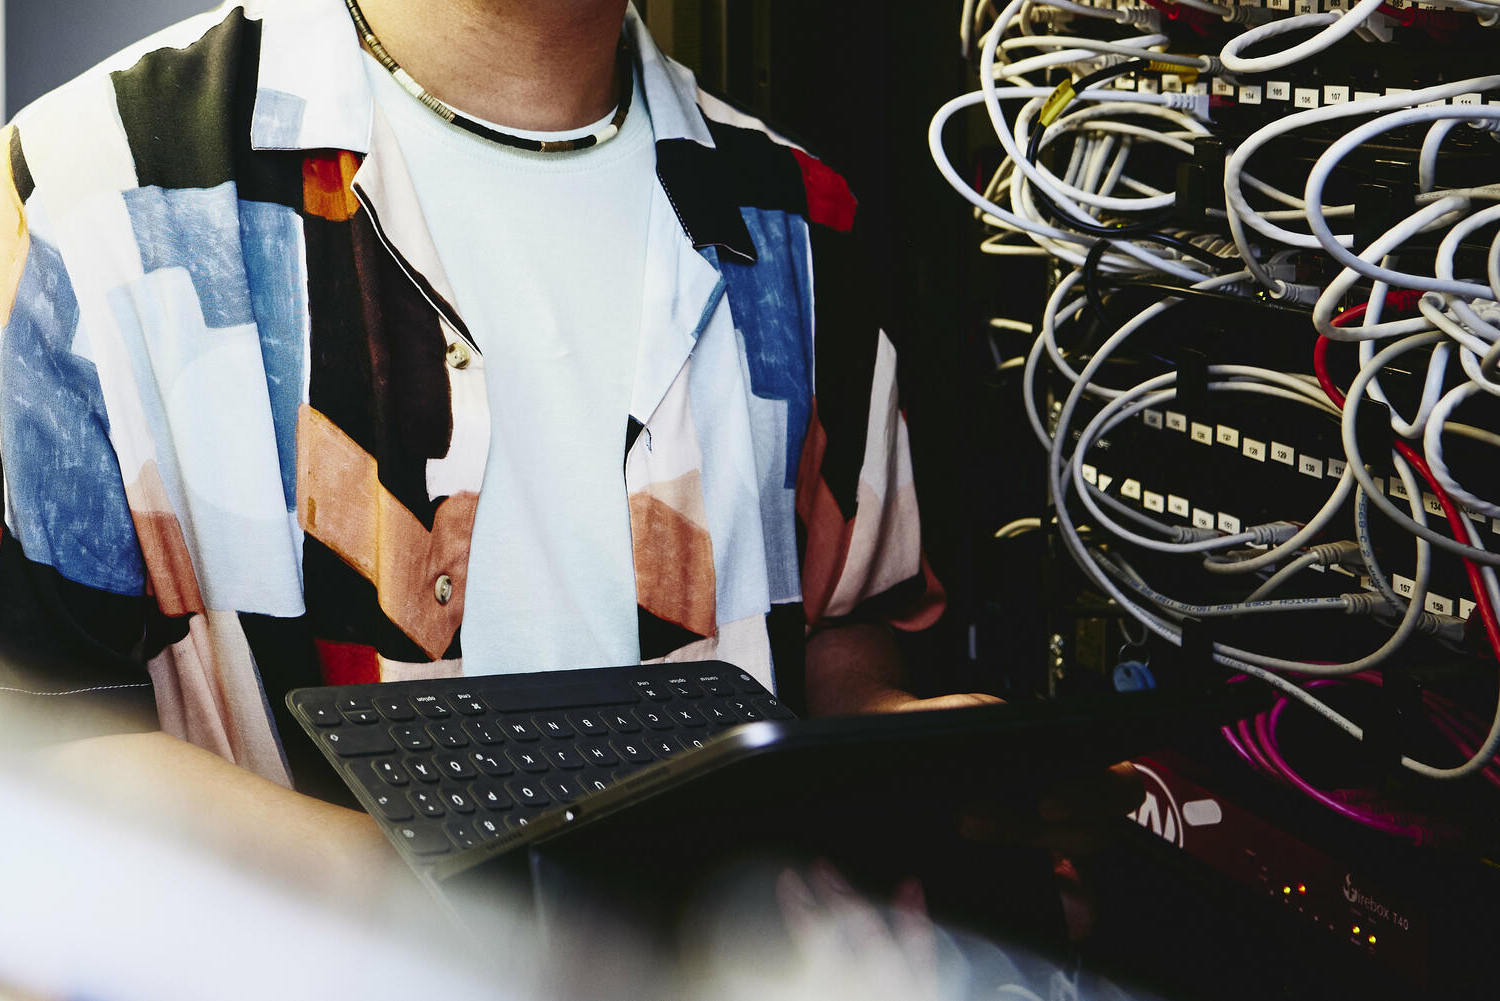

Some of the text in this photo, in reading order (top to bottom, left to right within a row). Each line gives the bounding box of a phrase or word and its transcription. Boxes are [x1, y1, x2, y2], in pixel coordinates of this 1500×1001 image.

[1272, 0, 1283, 7] 081
[1392, 0, 1404, 8] 085
[1300, 5, 1312, 13] 082
[1272, 87, 1283, 96] 105
[1331, 92, 1342, 101] 107
[1430, 501, 1442, 511] 134
[1399, 583, 1411, 594] 157
[1245, 600, 1273, 608] CORD
[1279, 597, 1318, 605] PATCH
[1432, 601, 1444, 612] 158
[512, 708, 723, 734] Y X C V B N M
[626, 745, 637, 755] G
[662, 743, 671, 753] F
[557, 751, 566, 761] J
[591, 748, 604, 759] H
[486, 757, 498, 768] L
[522, 755, 535, 765] K
[560, 784, 569, 794] I
[594, 780, 606, 790] U
[487, 790, 498, 802] P
[522, 787, 534, 798] O
[1392, 911, 1410, 931] T40
